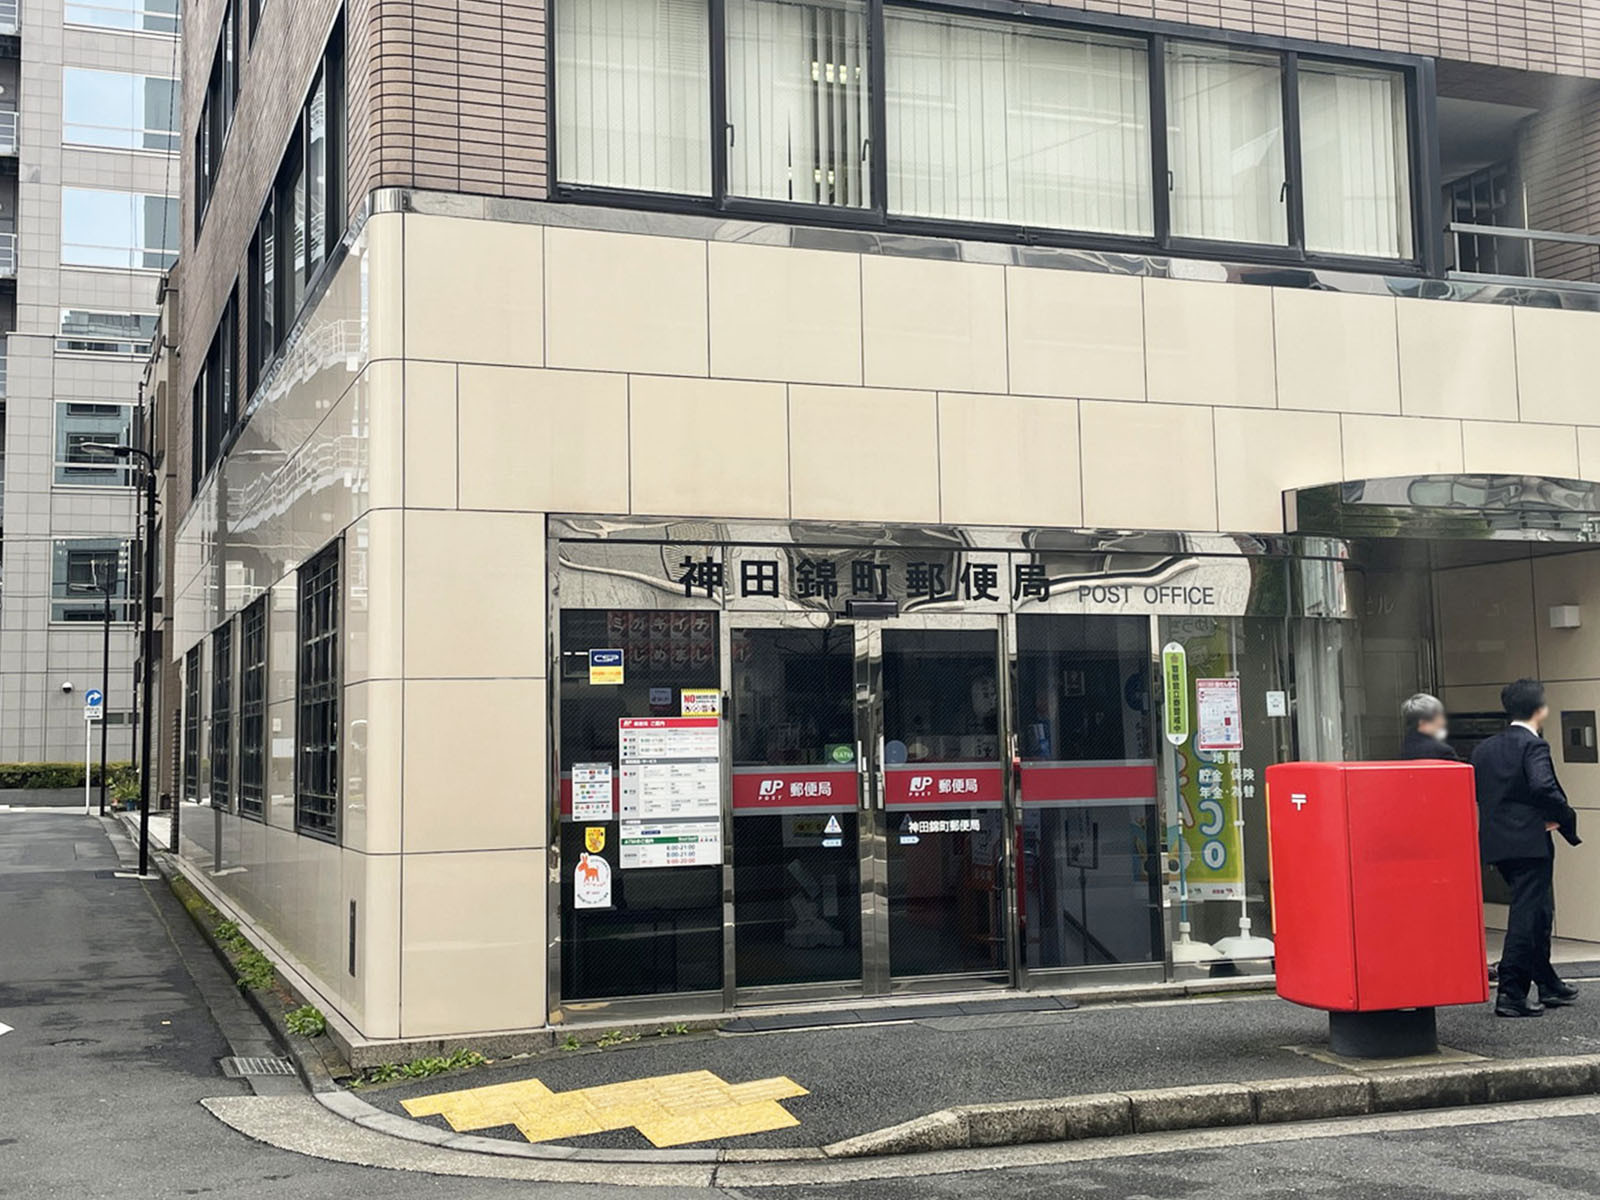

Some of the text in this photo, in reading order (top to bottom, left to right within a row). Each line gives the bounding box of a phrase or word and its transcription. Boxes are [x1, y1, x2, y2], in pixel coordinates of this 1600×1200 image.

[678, 555, 1051, 603] 神田錦町郵便局
[1078, 585, 1215, 606] POST OFFICE
[684, 695, 696, 703] NO
[790, 781, 832, 797] 郵便局
[938, 778, 978, 794] 郵便局
[908, 819, 981, 834] 神田錦町郵便局
